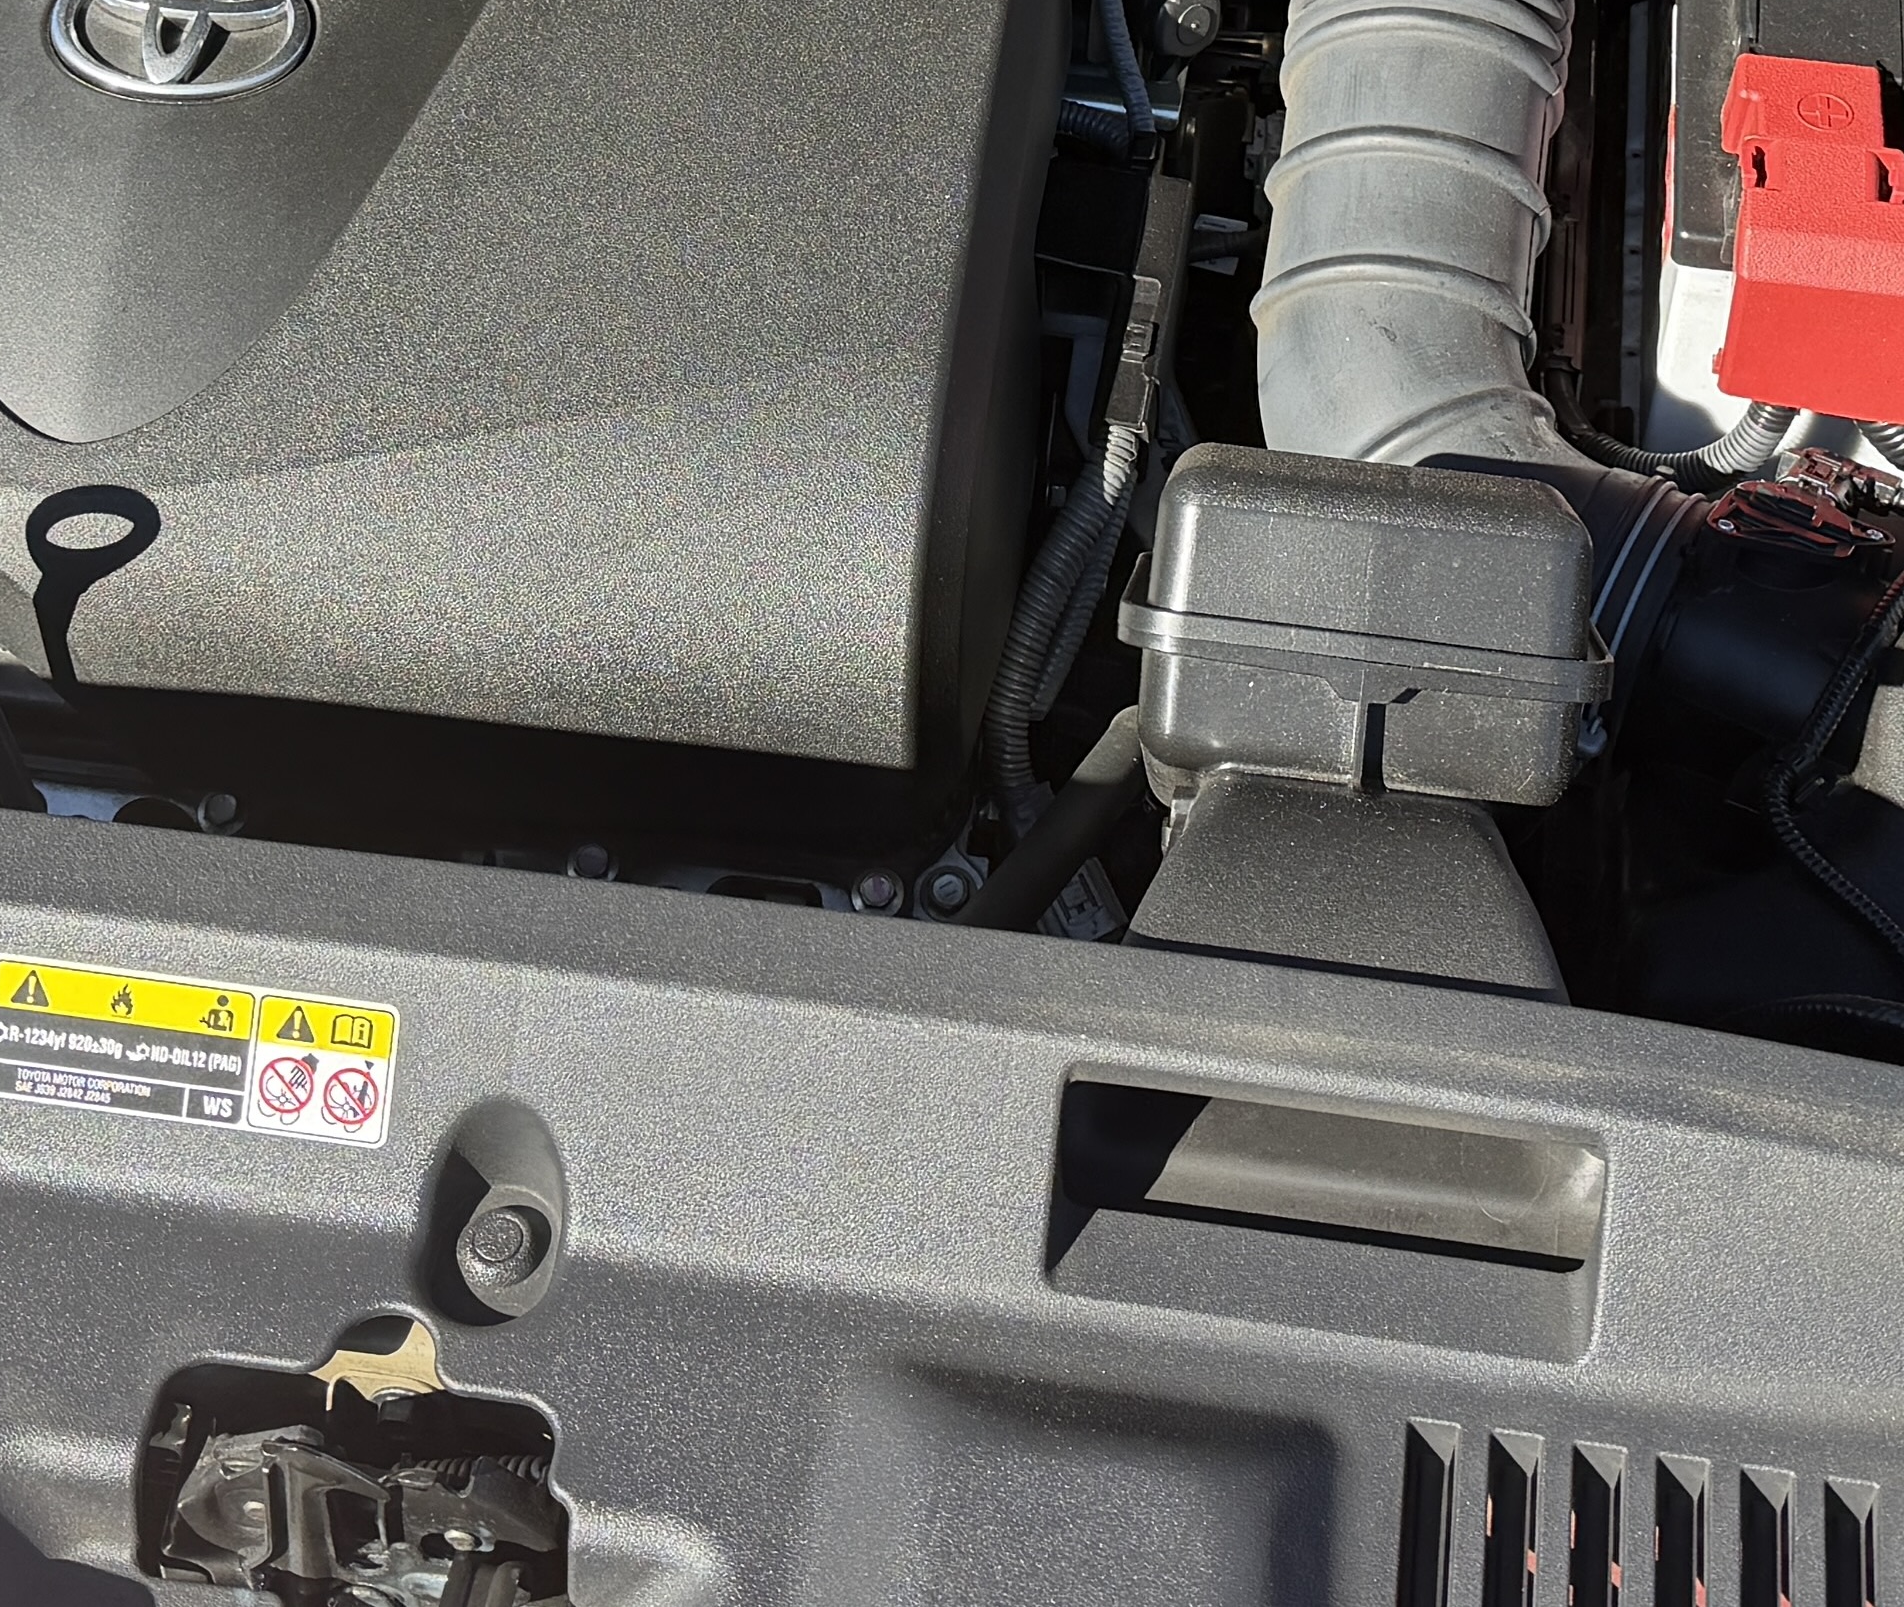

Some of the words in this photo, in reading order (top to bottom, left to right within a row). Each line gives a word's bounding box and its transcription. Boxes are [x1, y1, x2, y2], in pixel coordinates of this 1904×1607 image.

[8, 1024, 66, 1051] R-1234yf
[208, 1052, 243, 1076] (PAG)
[14, 1080, 34, 1093] SAE
[17, 1067, 51, 1084] TOYOTA
[52, 1072, 86, 1088] MOTOR
[87, 1077, 151, 1098] CORPORATION
[202, 1094, 234, 1119] WS
